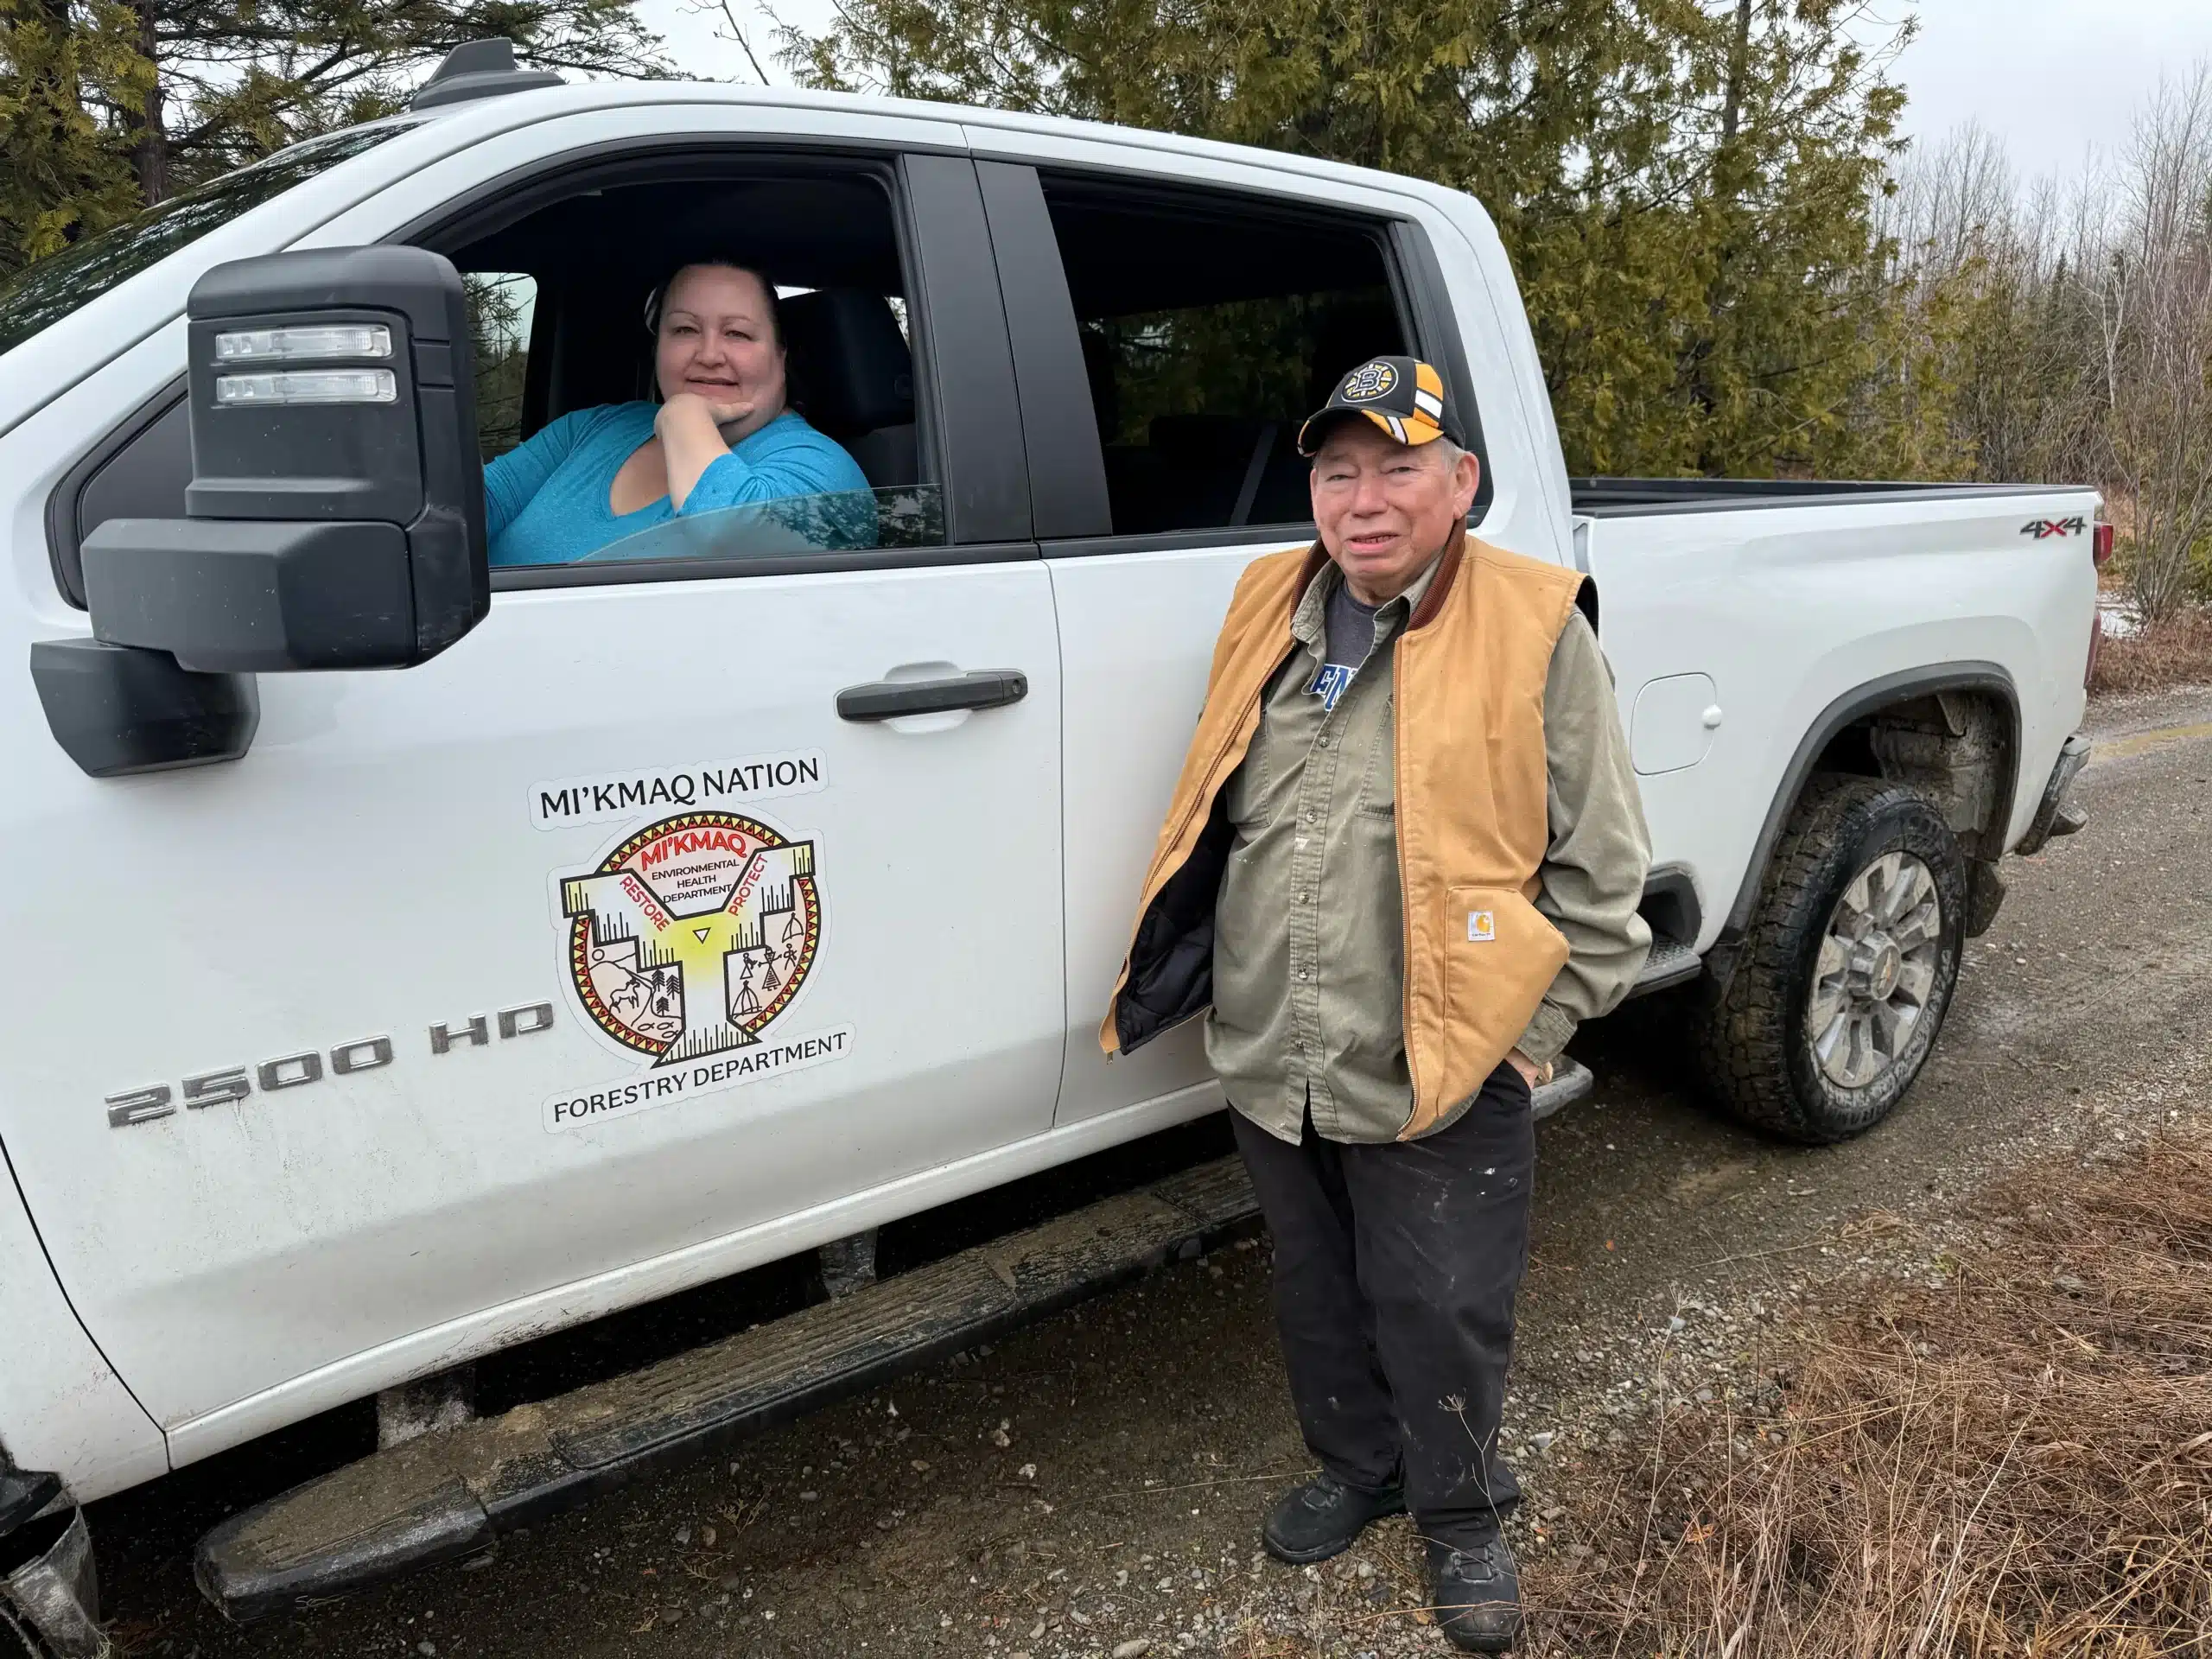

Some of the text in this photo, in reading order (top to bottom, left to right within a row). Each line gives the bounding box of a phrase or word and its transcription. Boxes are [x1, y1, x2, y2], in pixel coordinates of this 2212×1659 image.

[540, 758, 819, 818] MI'KMAQ NATION
[641, 831, 747, 871] MI'KMAQ
[652, 859, 740, 880] ENVIRONMENTAL
[619, 875, 671, 931] RESTORE
[663, 884, 732, 904] DEPARTMENT
[677, 874, 717, 889] HEALTH
[728, 854, 768, 916] PROTECT
[105, 1000, 554, 1128] 2500 HD
[554, 1033, 847, 1122] FORESTRY DEPARTMENT
